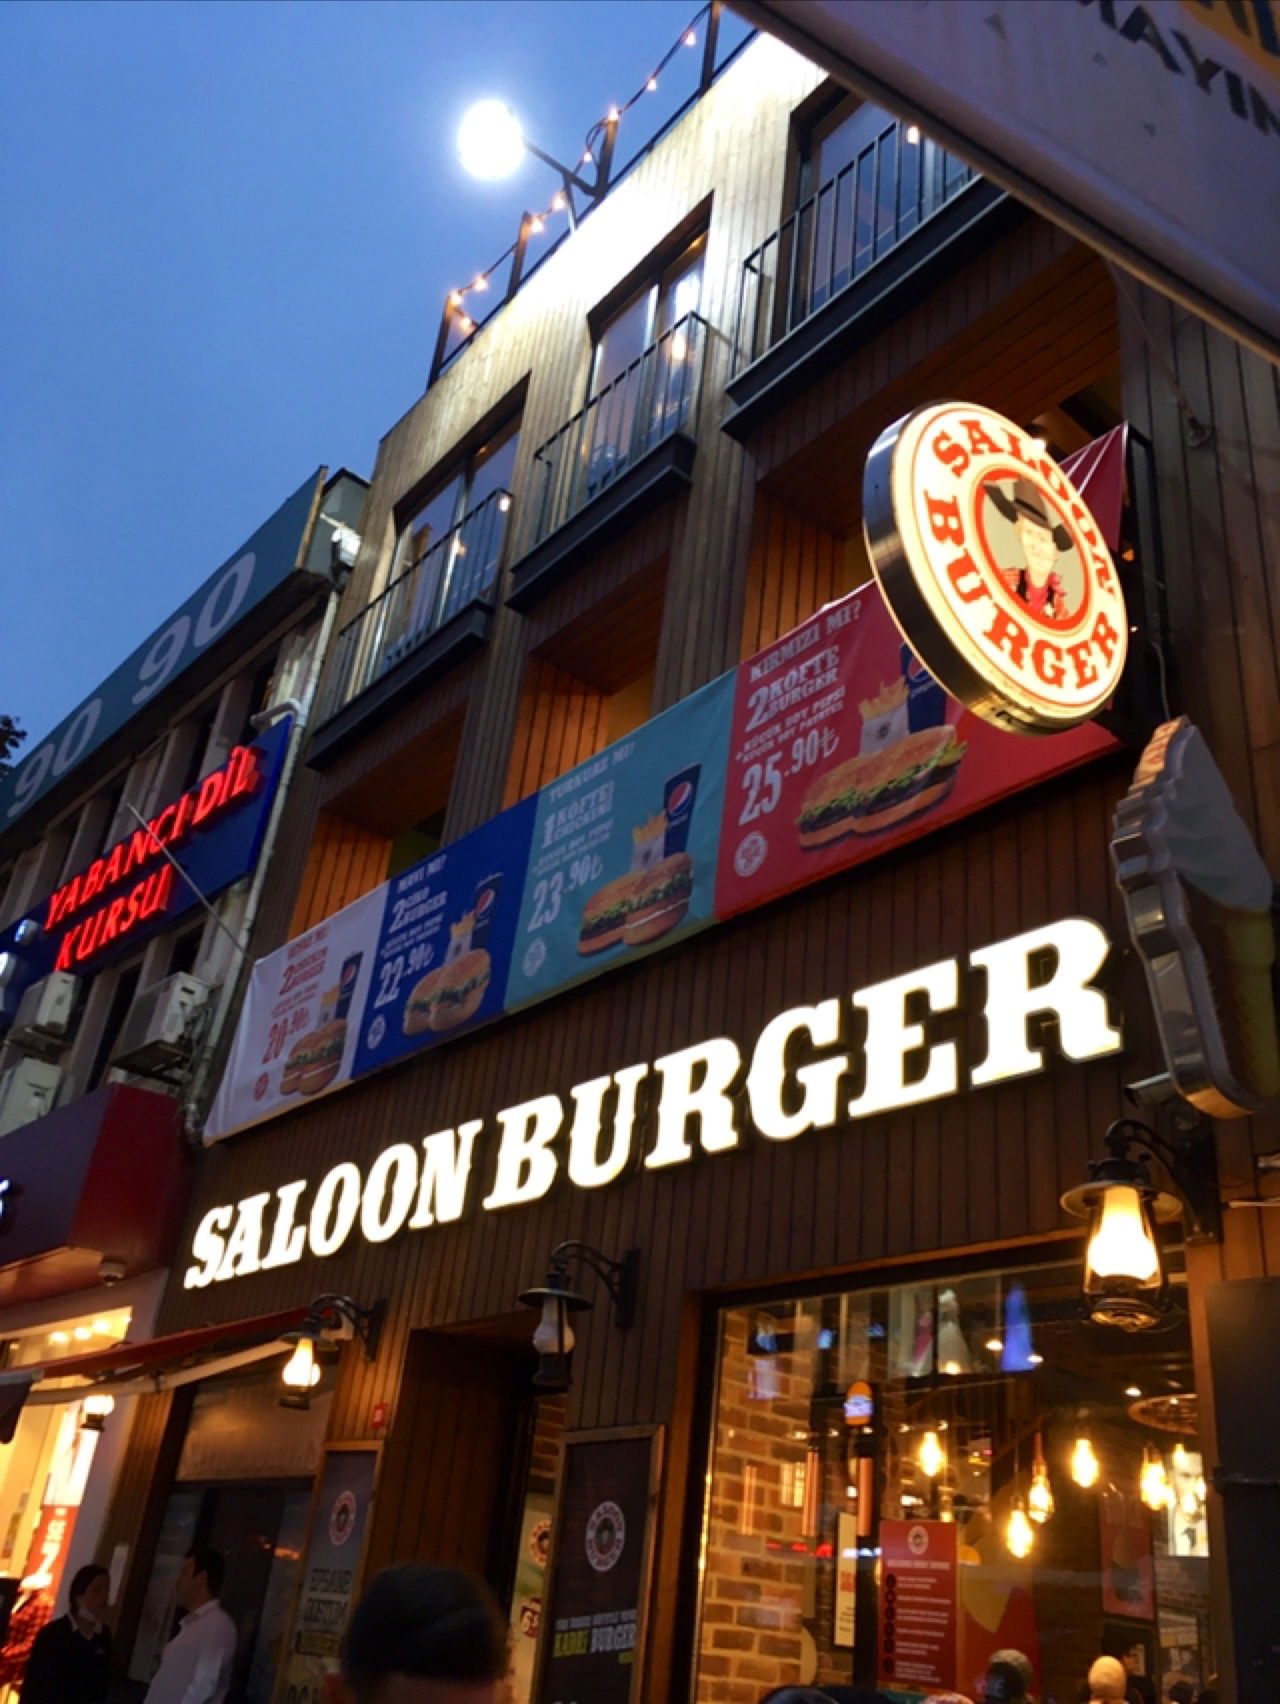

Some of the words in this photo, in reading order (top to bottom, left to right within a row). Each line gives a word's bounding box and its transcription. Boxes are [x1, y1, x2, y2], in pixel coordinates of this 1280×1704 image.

[132, 551, 256, 705] 90
[923, 489, 1119, 690] BURGER
[7, 697, 103, 819] 90
[767, 667, 839, 720] BURGER
[45, 794, 193, 932] YABANCI
[54, 863, 174, 971] KURSU
[182, 1119, 482, 1290] SALOON
[483, 916, 1123, 1211] BURGER
